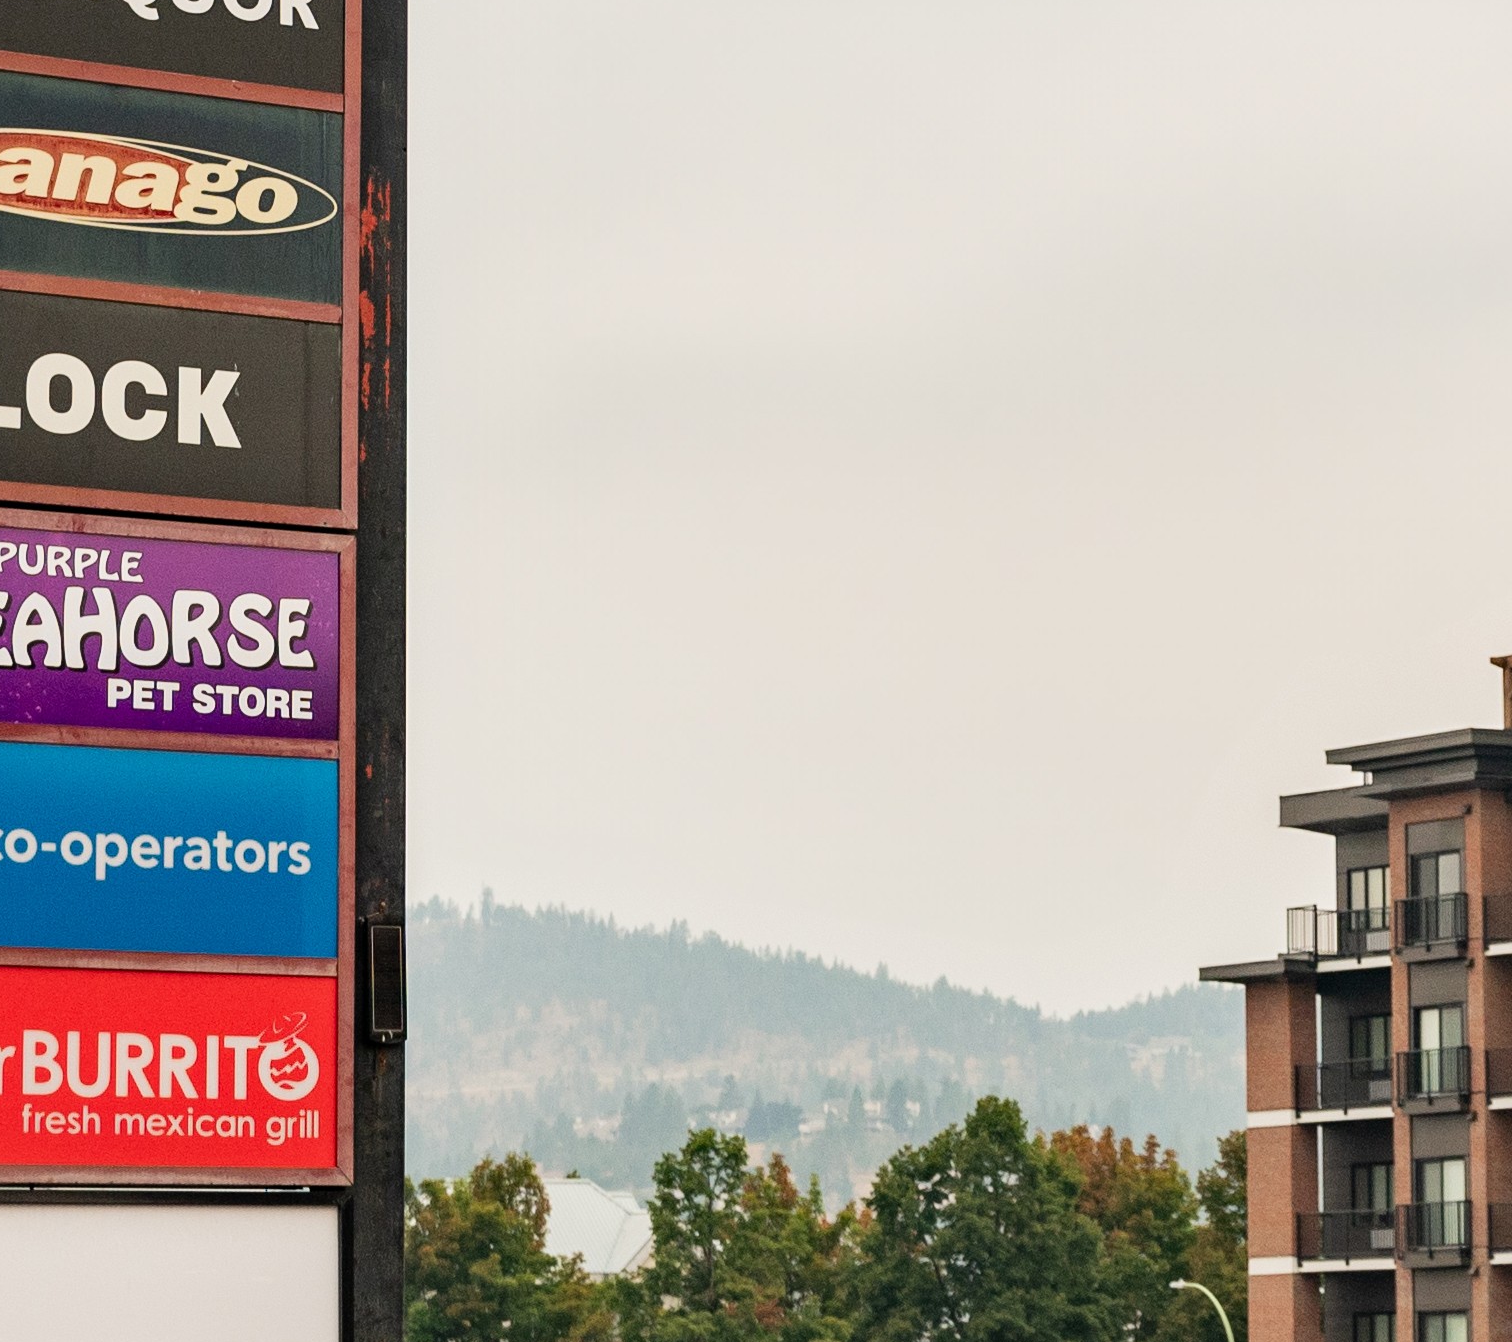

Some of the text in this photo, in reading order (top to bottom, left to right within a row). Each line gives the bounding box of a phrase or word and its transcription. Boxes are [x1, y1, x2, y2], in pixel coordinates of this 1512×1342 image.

[106, 678, 314, 721] PET STORE
[22, 1103, 320, 1147] fresh mexican grill
